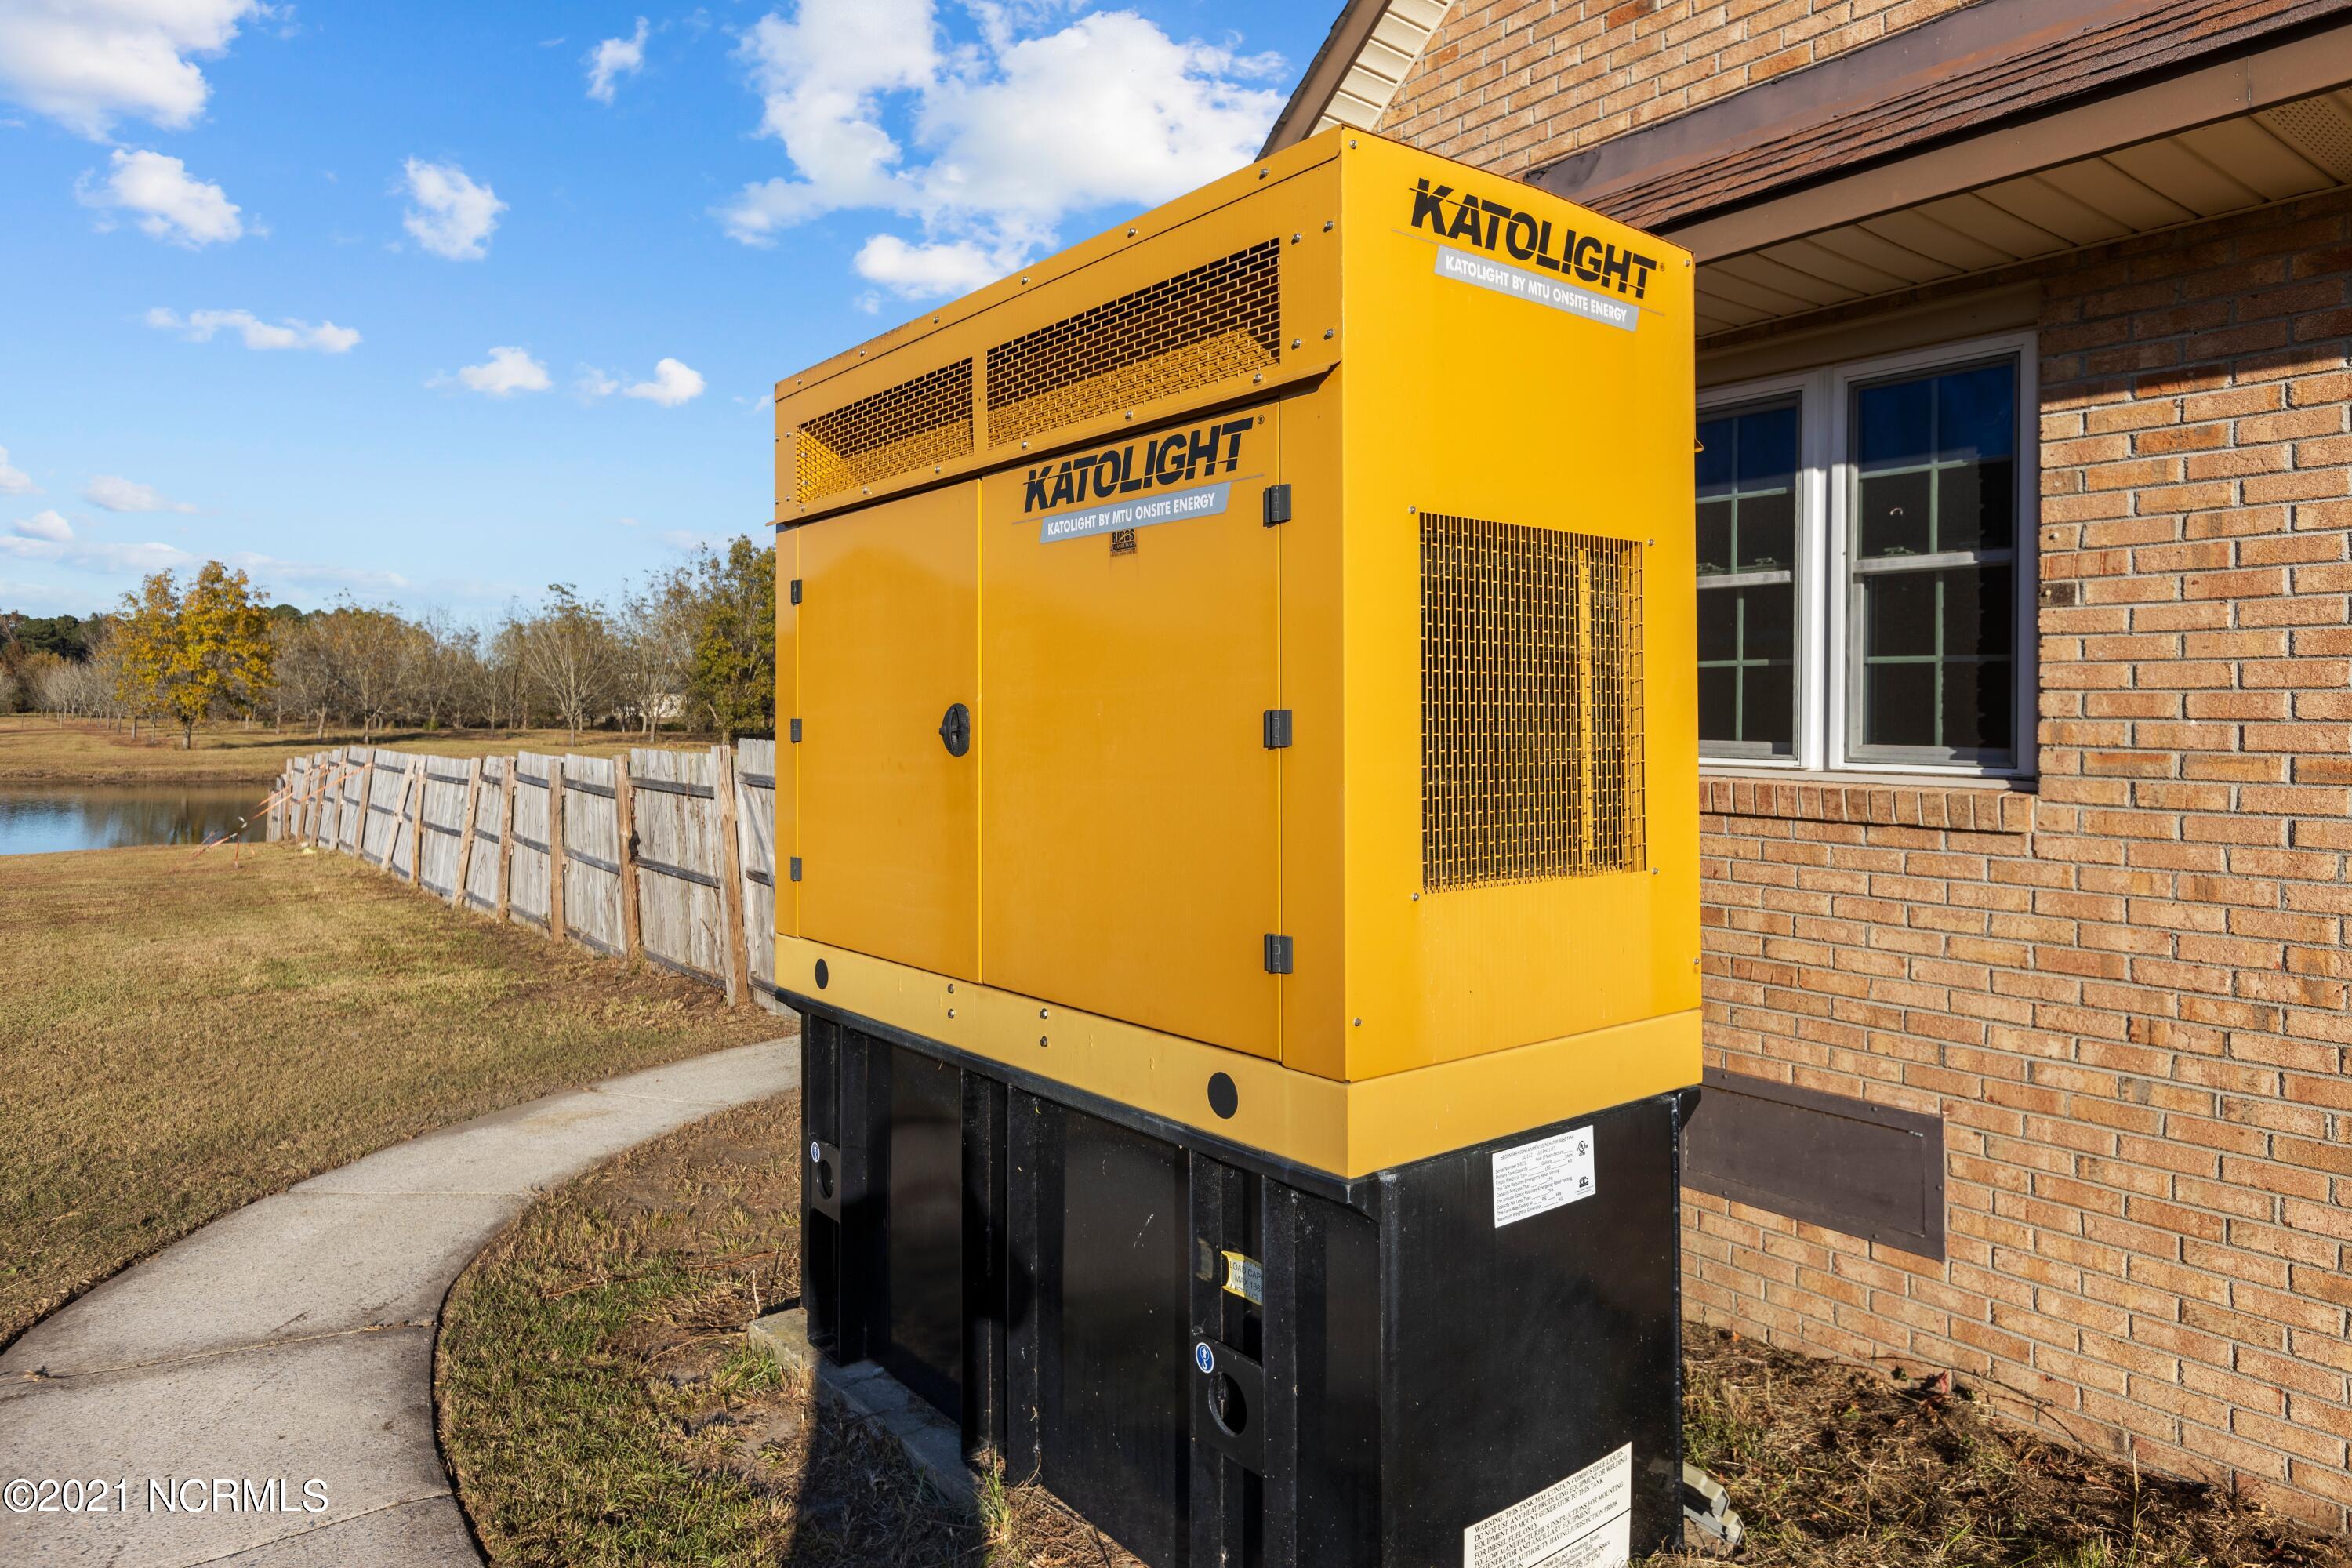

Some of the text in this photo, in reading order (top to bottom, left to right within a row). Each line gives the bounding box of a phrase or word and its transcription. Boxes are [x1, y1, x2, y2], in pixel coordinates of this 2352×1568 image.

[1410, 177, 1657, 299] KATOLIGHT
[1446, 255, 1627, 322] KATOLIGHT BY MTU ONSITE ENERGY
[1023, 416, 1254, 513] KATOLIGHT
[1047, 492, 1215, 535] KATOLIGHT BY MTU ONSITE ENERGY
[1475, 1533, 1483, 1542] DO
[1485, 1526, 1497, 1537] NOT
[1497, 1520, 1508, 1530] USE
[1511, 1514, 1521, 1523] ANY
[1523, 1506, 1537, 1517] HEAT
[1538, 1489, 1568, 1509] PRODUCING
[1570, 1472, 1598, 1494] EQUIPMENT
[1606, 1455, 1627, 1472] WELDING
[1475, 1529, 1508, 1551] EQUIPMENT
[1519, 1514, 1537, 1528] MOUNT
[1539, 1497, 1569, 1518] GENERATOR
[1579, 1486, 1589, 1495] THIS
[1591, 1478, 1603, 1489] TANK
[1505, 1508, 1518, 1519] THIS
[1519, 1500, 1534, 1511] TANK
[1535, 1494, 1545, 1503] MAY
[1548, 1481, 1570, 1497] CONTAIN
[1572, 1461, 1605, 1483] COMBUSTIBLE
[1475, 1552, 1497, 1568] FOLLOW
[1550, 1504, 1586, 1528] INSTRUCTIONS
[1588, 1498, 1597, 1507] FOR
[1598, 1481, 1623, 1501] MOUNTING
[1475, 1523, 1537, 1559] FOR DIESEL FUEL ONLY
[1519, 1541, 1530, 1552] AND
[1533, 1525, 1561, 1545] ANCILLARY
[1562, 1508, 1591, 1529] EQUIPMENT
[1519, 1541, 1548, 1562] AUTHORITY
[1549, 1529, 1570, 1544] HAVING
